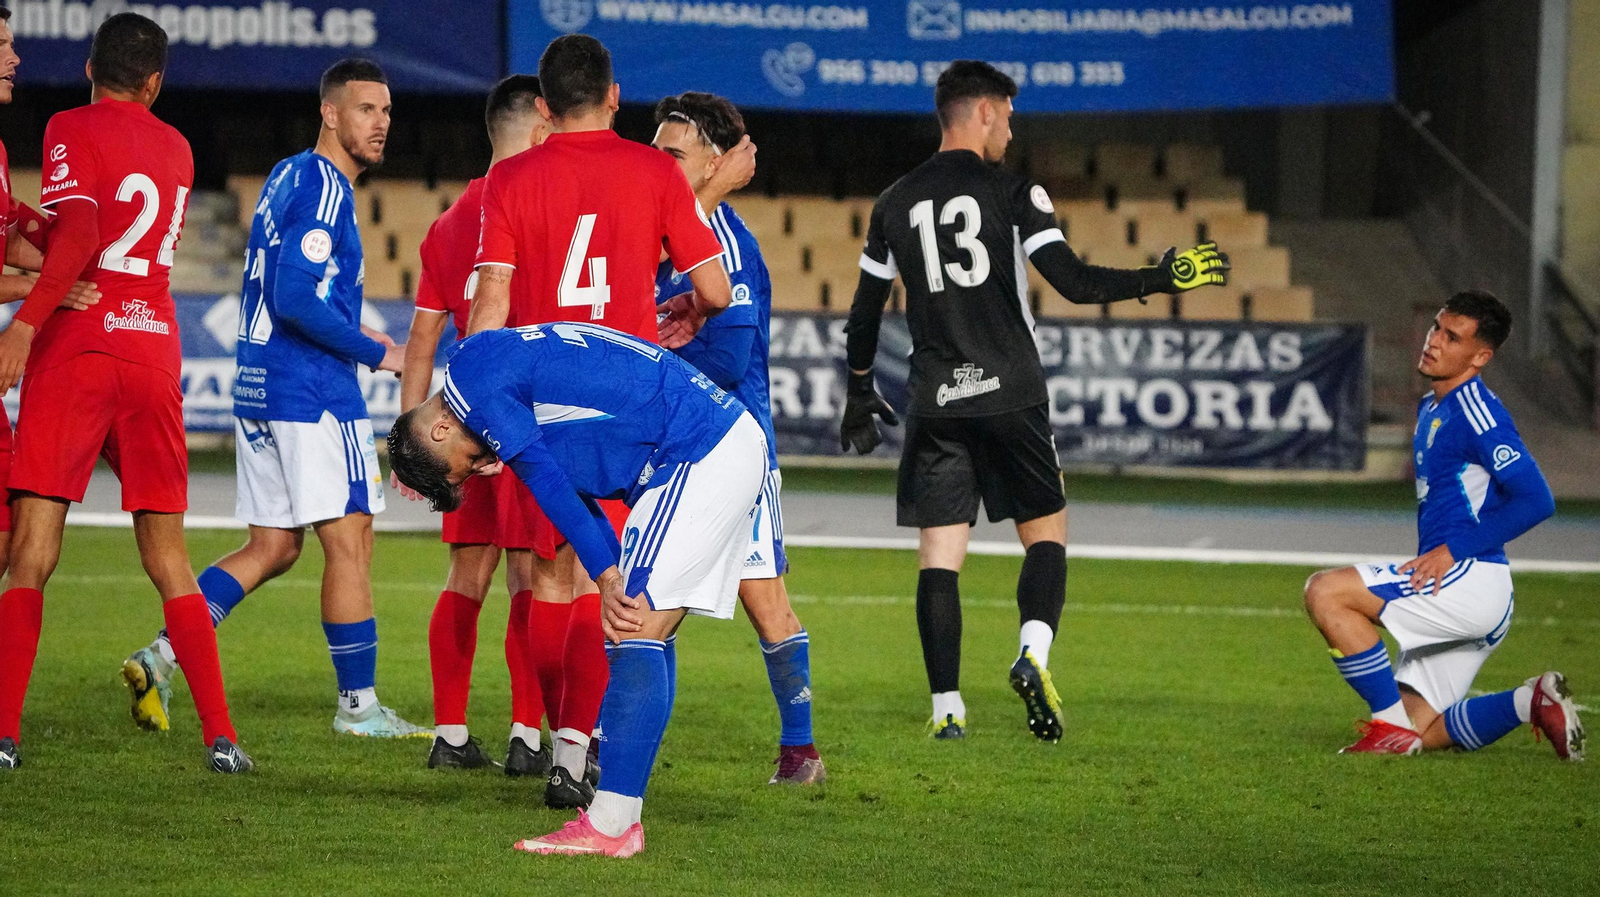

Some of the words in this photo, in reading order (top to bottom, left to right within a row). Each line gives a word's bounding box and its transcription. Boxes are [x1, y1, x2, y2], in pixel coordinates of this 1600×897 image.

[42, 179, 78, 195] BALEARIA
[908, 195, 991, 293] 13
[557, 213, 611, 320] 4
[104, 311, 169, 335] Casablanca
[936, 376, 1001, 407] Casablanca
[744, 559, 766, 567] adidas
